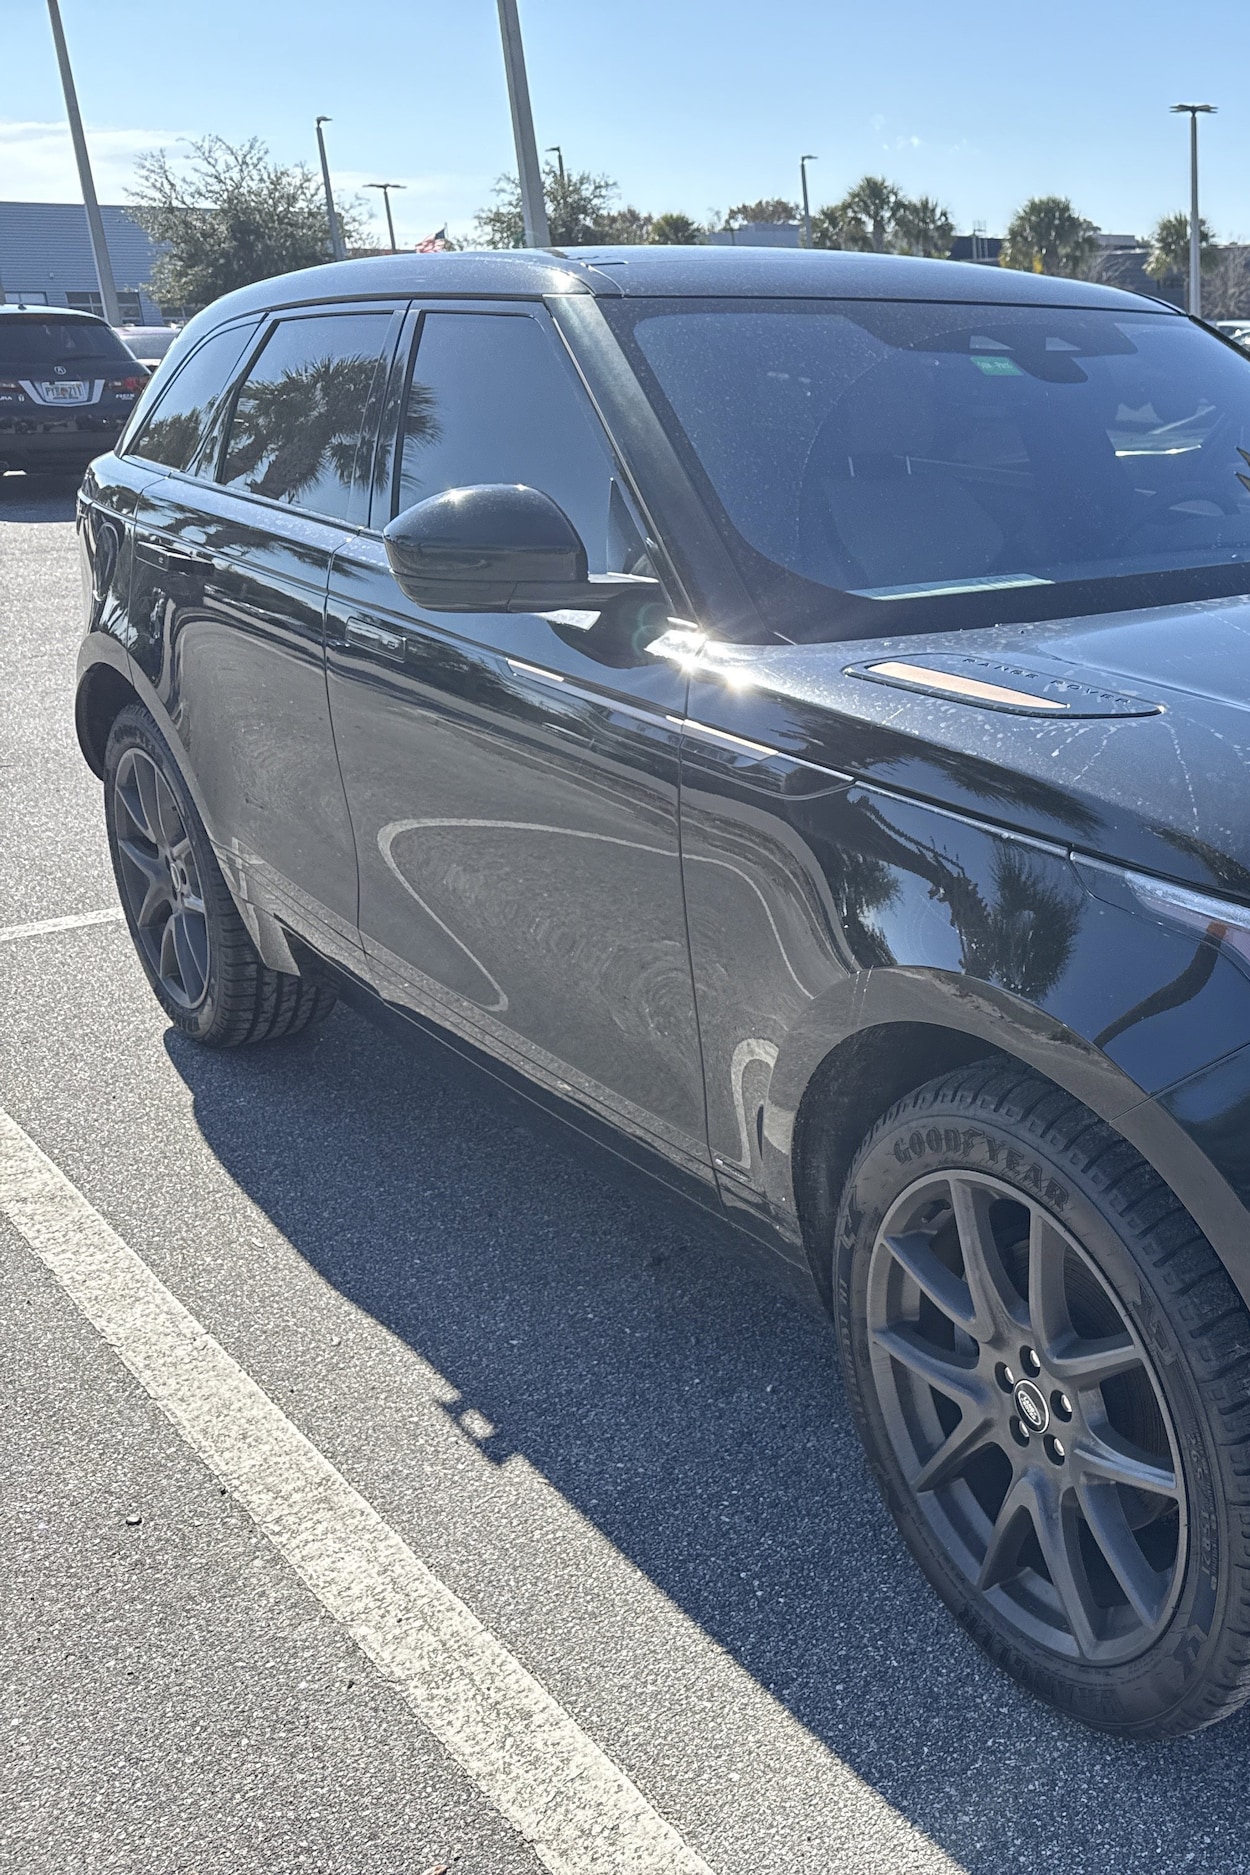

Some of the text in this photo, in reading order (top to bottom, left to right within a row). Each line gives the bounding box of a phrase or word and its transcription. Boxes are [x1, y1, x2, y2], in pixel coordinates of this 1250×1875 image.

[962, 657, 1131, 704] RANGE ROVER
[892, 1126, 1070, 1213] GOODYEAR
